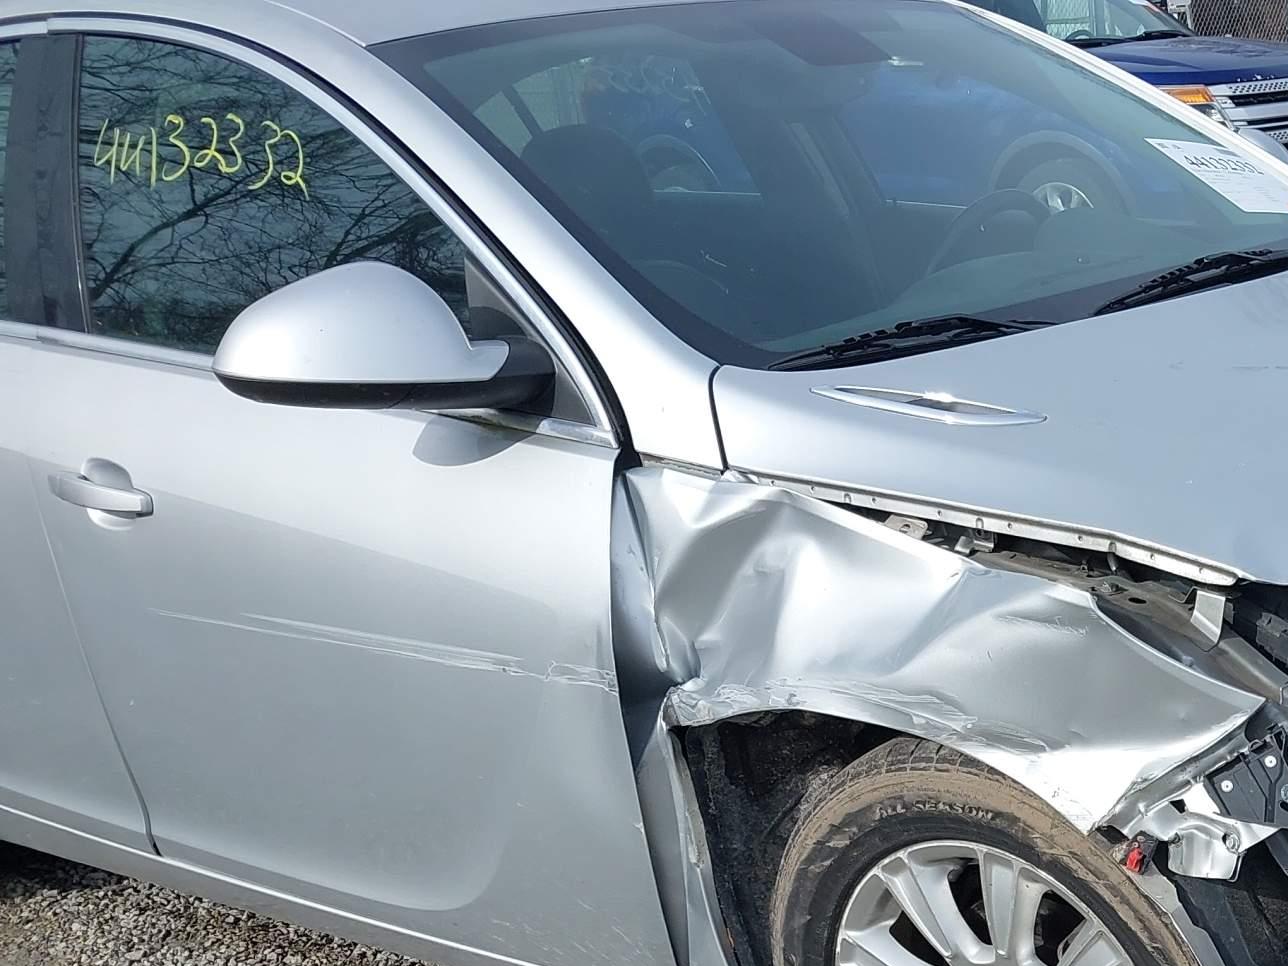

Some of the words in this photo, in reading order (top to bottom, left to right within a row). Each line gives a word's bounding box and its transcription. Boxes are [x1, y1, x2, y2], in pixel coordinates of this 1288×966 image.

[94, 113, 309, 200] 44132332
[874, 803, 906, 820] ALL
[912, 799, 993, 823] SEASON
